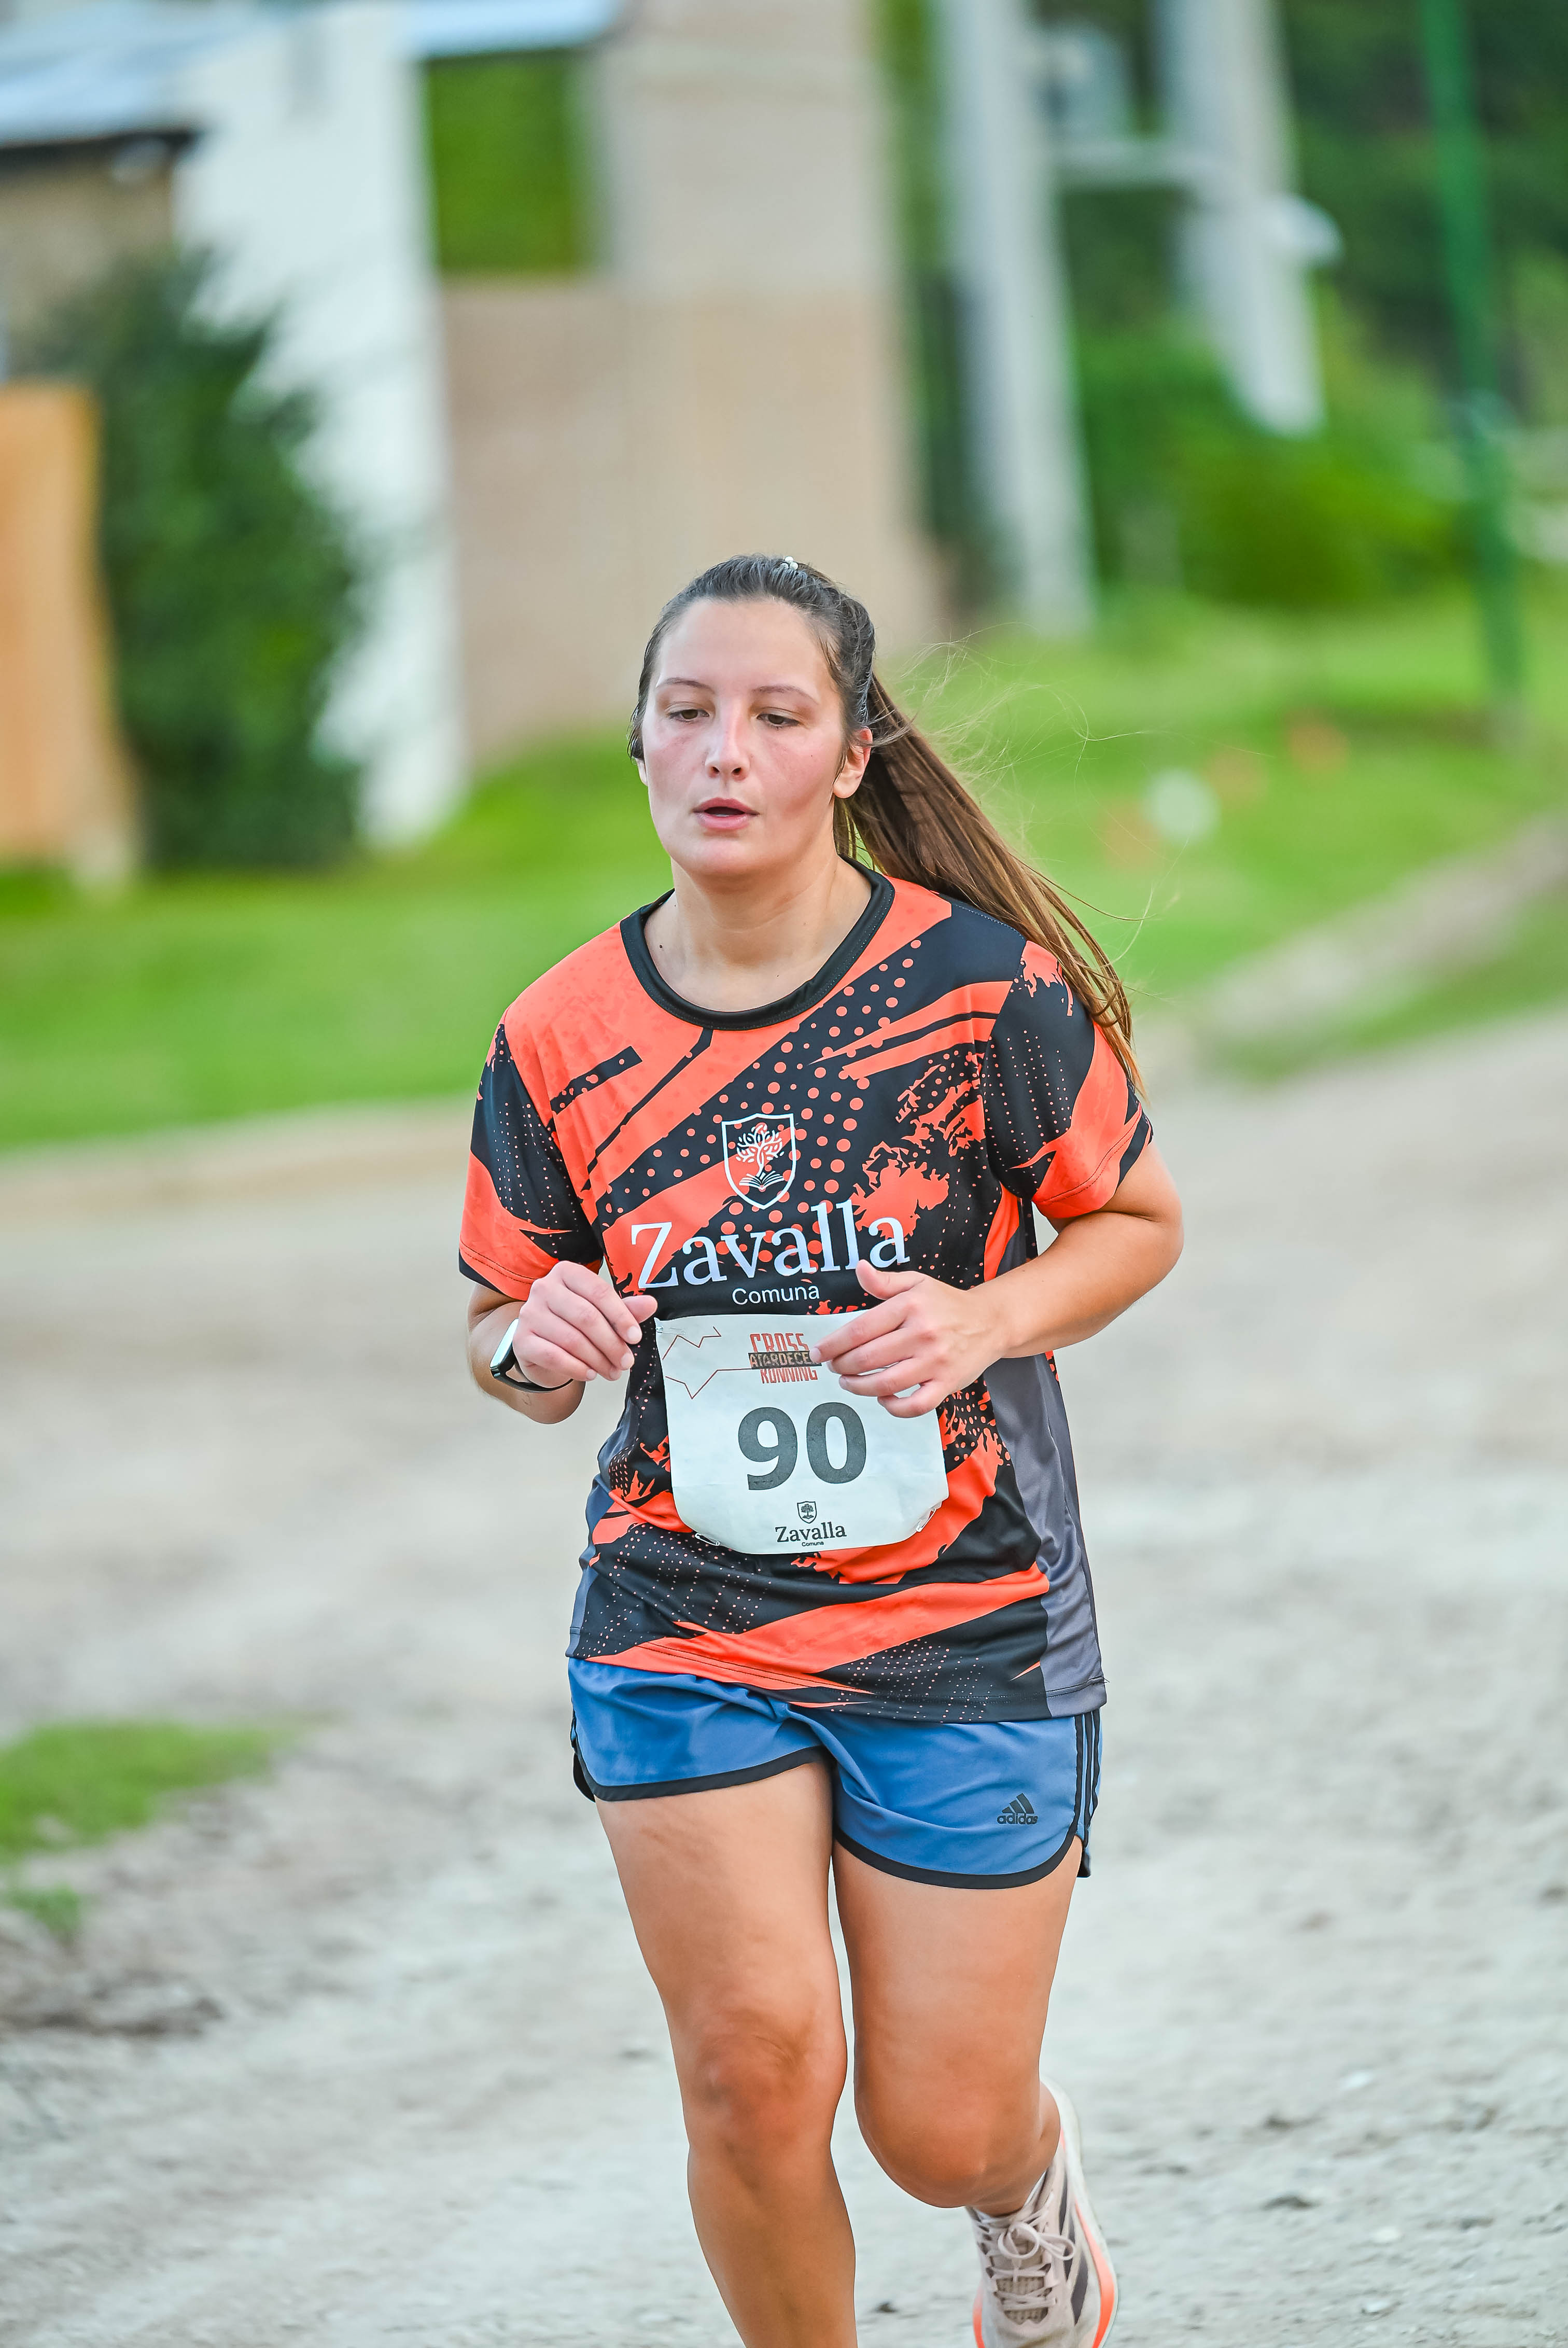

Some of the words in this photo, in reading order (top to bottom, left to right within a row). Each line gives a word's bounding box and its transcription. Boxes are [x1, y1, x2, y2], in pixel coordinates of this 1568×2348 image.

[631, 1199, 910, 1289] Zavalla
[732, 1283, 820, 1305] Comuna
[750, 1333, 809, 1352] CROSS
[749, 1352, 820, 1368] ATARDECE
[738, 1402, 867, 1490] 90
[775, 1521, 847, 1543] Zavalla
[997, 1813, 1039, 1825] adidas
